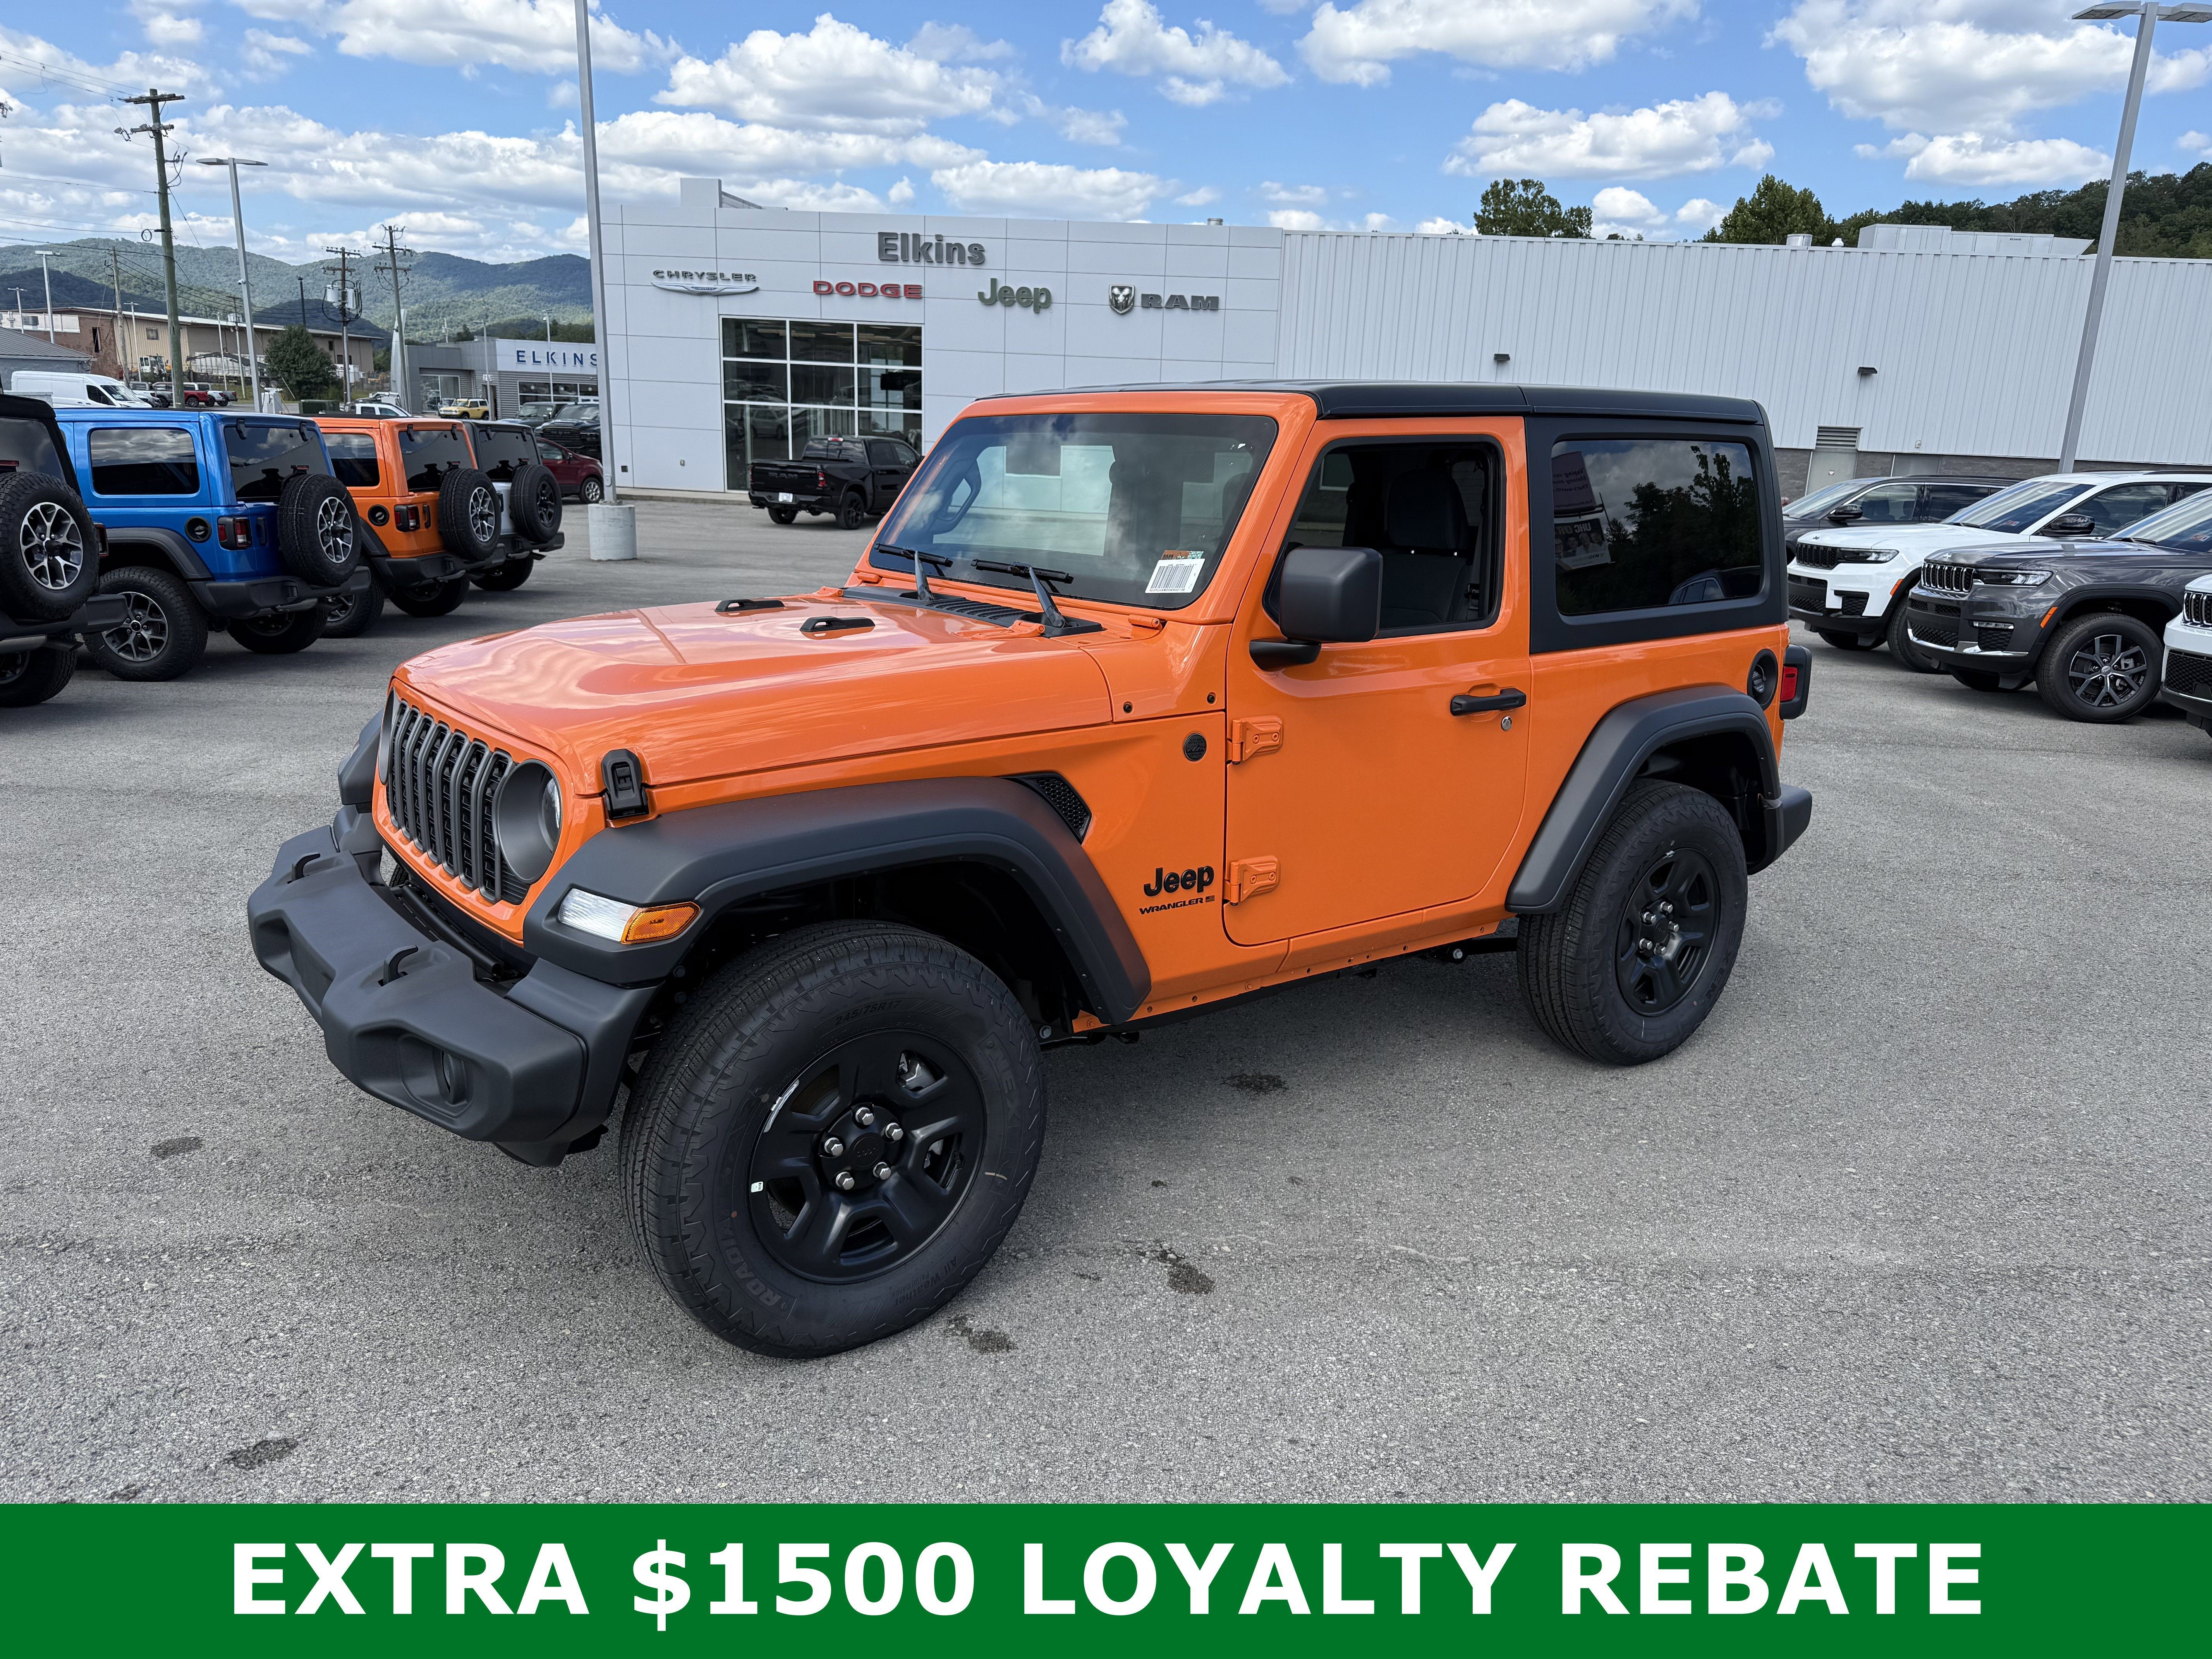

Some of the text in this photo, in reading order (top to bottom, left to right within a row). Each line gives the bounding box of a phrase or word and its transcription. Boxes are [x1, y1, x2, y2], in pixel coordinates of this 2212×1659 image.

[878, 232, 986, 264] Elkins
[653, 270, 756, 282] CHRYSLER
[813, 280, 923, 299] DODGE
[977, 278, 1052, 313] Jeep
[1141, 293, 1219, 310] RAM
[517, 350, 597, 366] ELKINS
[1144, 866, 1214, 896] Jeep
[1139, 898, 1203, 915] WRANGLER
[1705, 915, 1739, 1000] EXEN
[835, 1000, 902, 1026] 245/75R17
[718, 1200, 781, 1306] ROADIA
[894, 1256, 957, 1307] All-Weather
